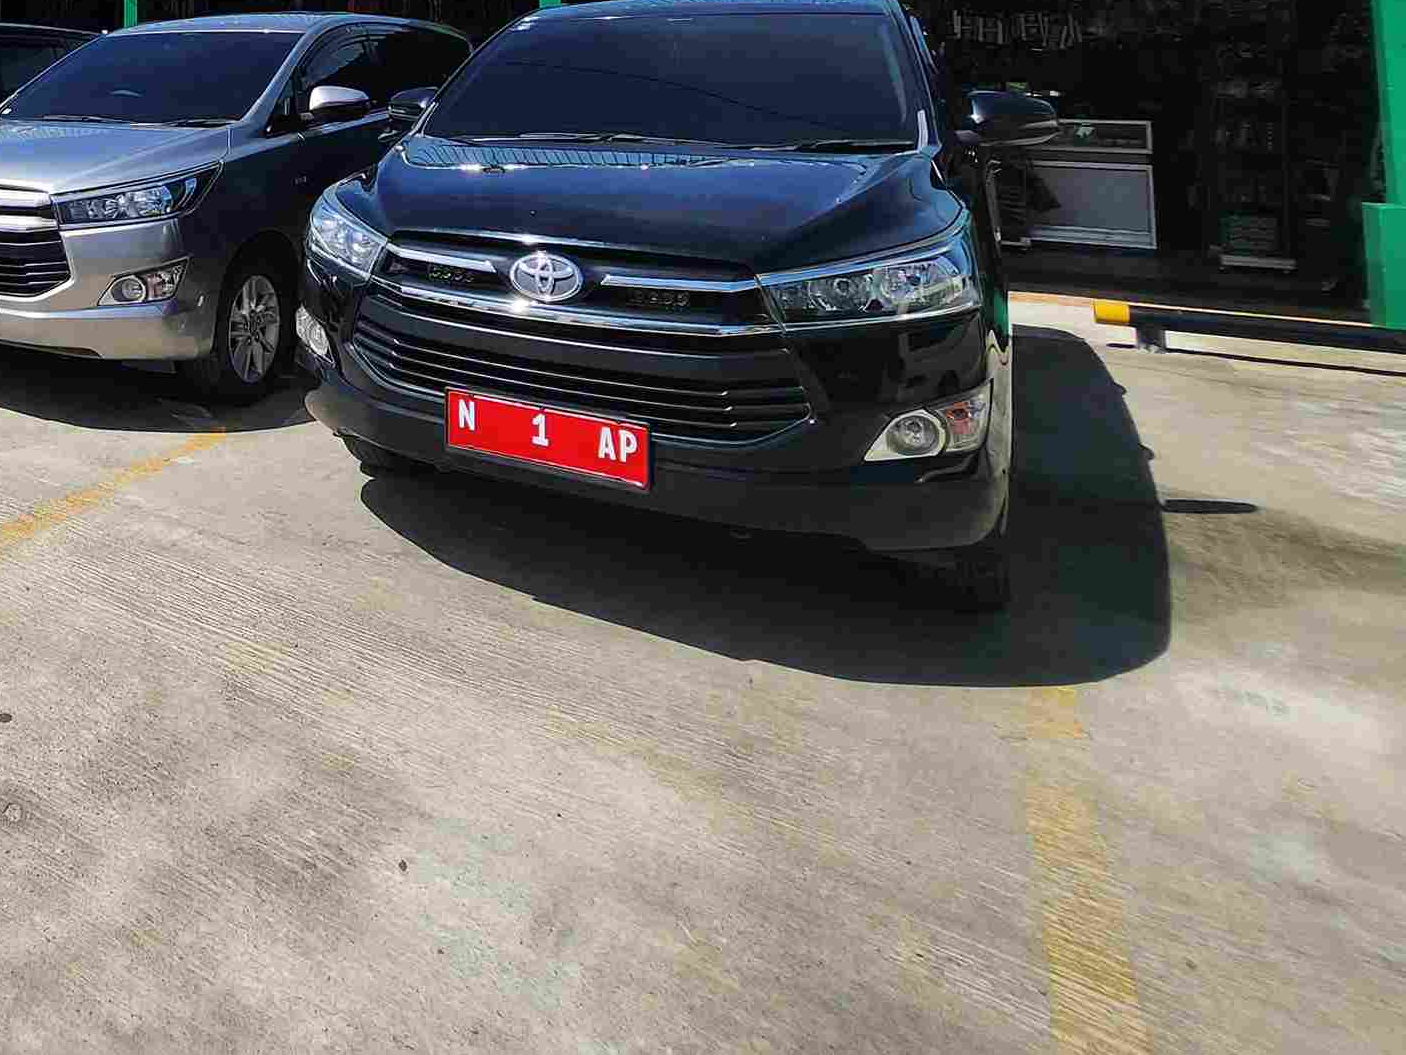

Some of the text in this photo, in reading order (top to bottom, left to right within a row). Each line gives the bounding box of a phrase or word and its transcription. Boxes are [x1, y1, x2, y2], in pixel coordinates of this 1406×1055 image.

[458, 399, 638, 463] N 1 AP
